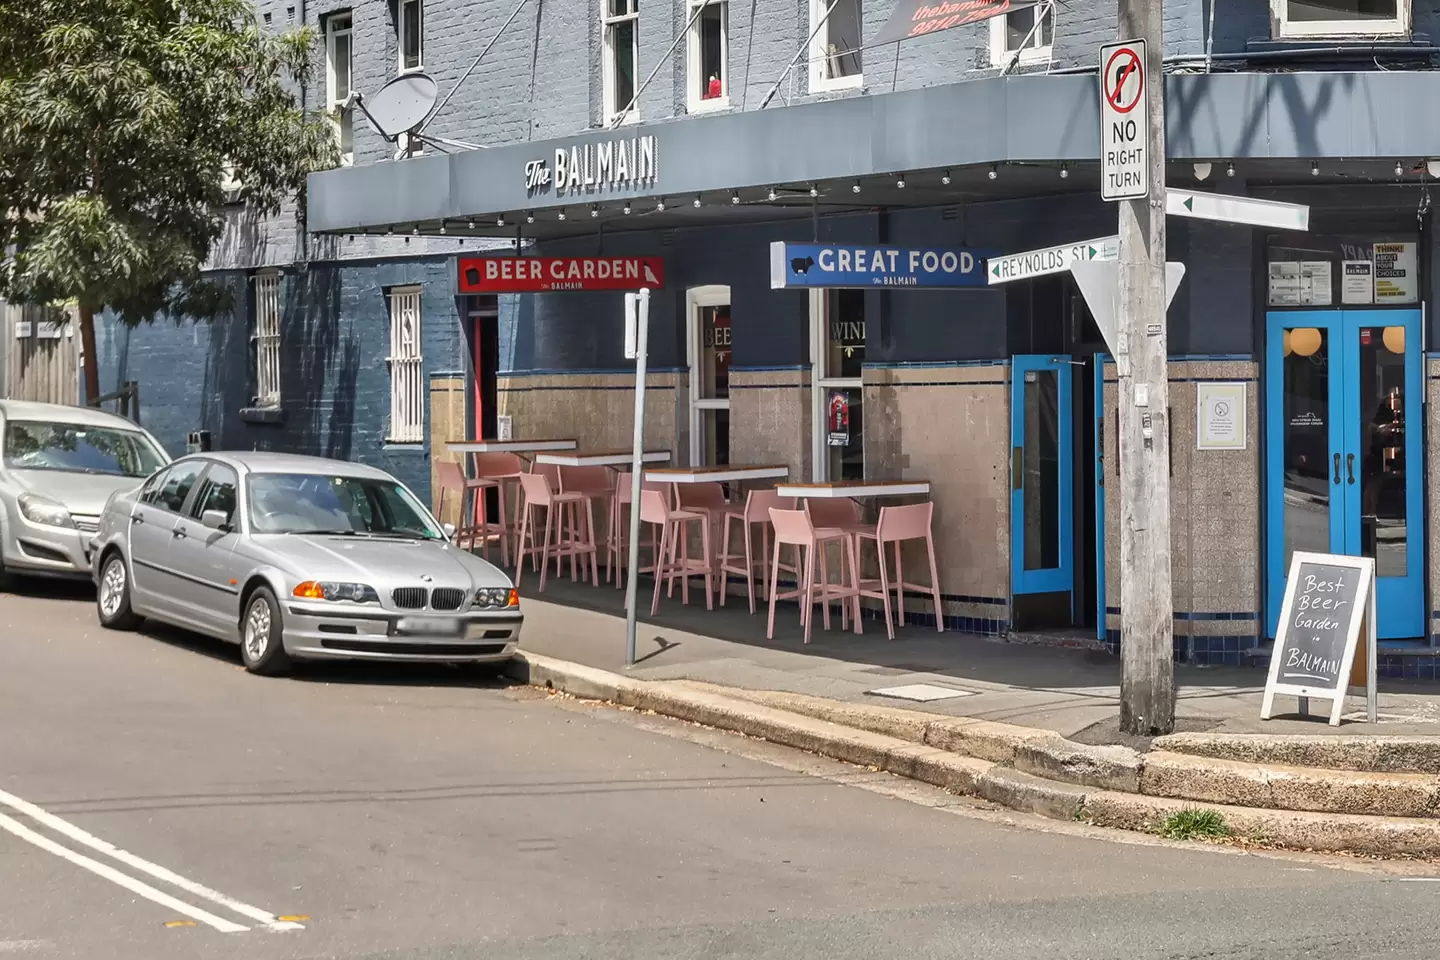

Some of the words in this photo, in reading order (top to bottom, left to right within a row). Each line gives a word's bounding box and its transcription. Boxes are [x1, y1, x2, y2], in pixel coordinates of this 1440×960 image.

[1112, 120, 1137, 144] NO
[525, 159, 551, 190] The
[555, 135, 657, 190] BALMAIN
[1107, 148, 1143, 167] RIGHT
[1108, 171, 1142, 189] TURN
[1376, 244, 1404, 253] THINK!
[485, 260, 543, 280] BEER
[550, 259, 639, 280] GARDEN
[818, 248, 899, 273] GREAT
[909, 251, 974, 274] FOOD
[1002, 249, 1064, 279] REYNOLDS
[1072, 245, 1087, 261] ST
[551, 281, 583, 290] BALMAIN
[883, 276, 917, 285] BALMAIN
[832, 320, 866, 340] WIN
[1303, 574, 1345, 593] Best
[1298, 595, 1347, 611] Beer
[1294, 611, 1339, 630] Garden
[1312, 634, 1320, 642] in
[1286, 647, 1340, 674] BALMAIN
